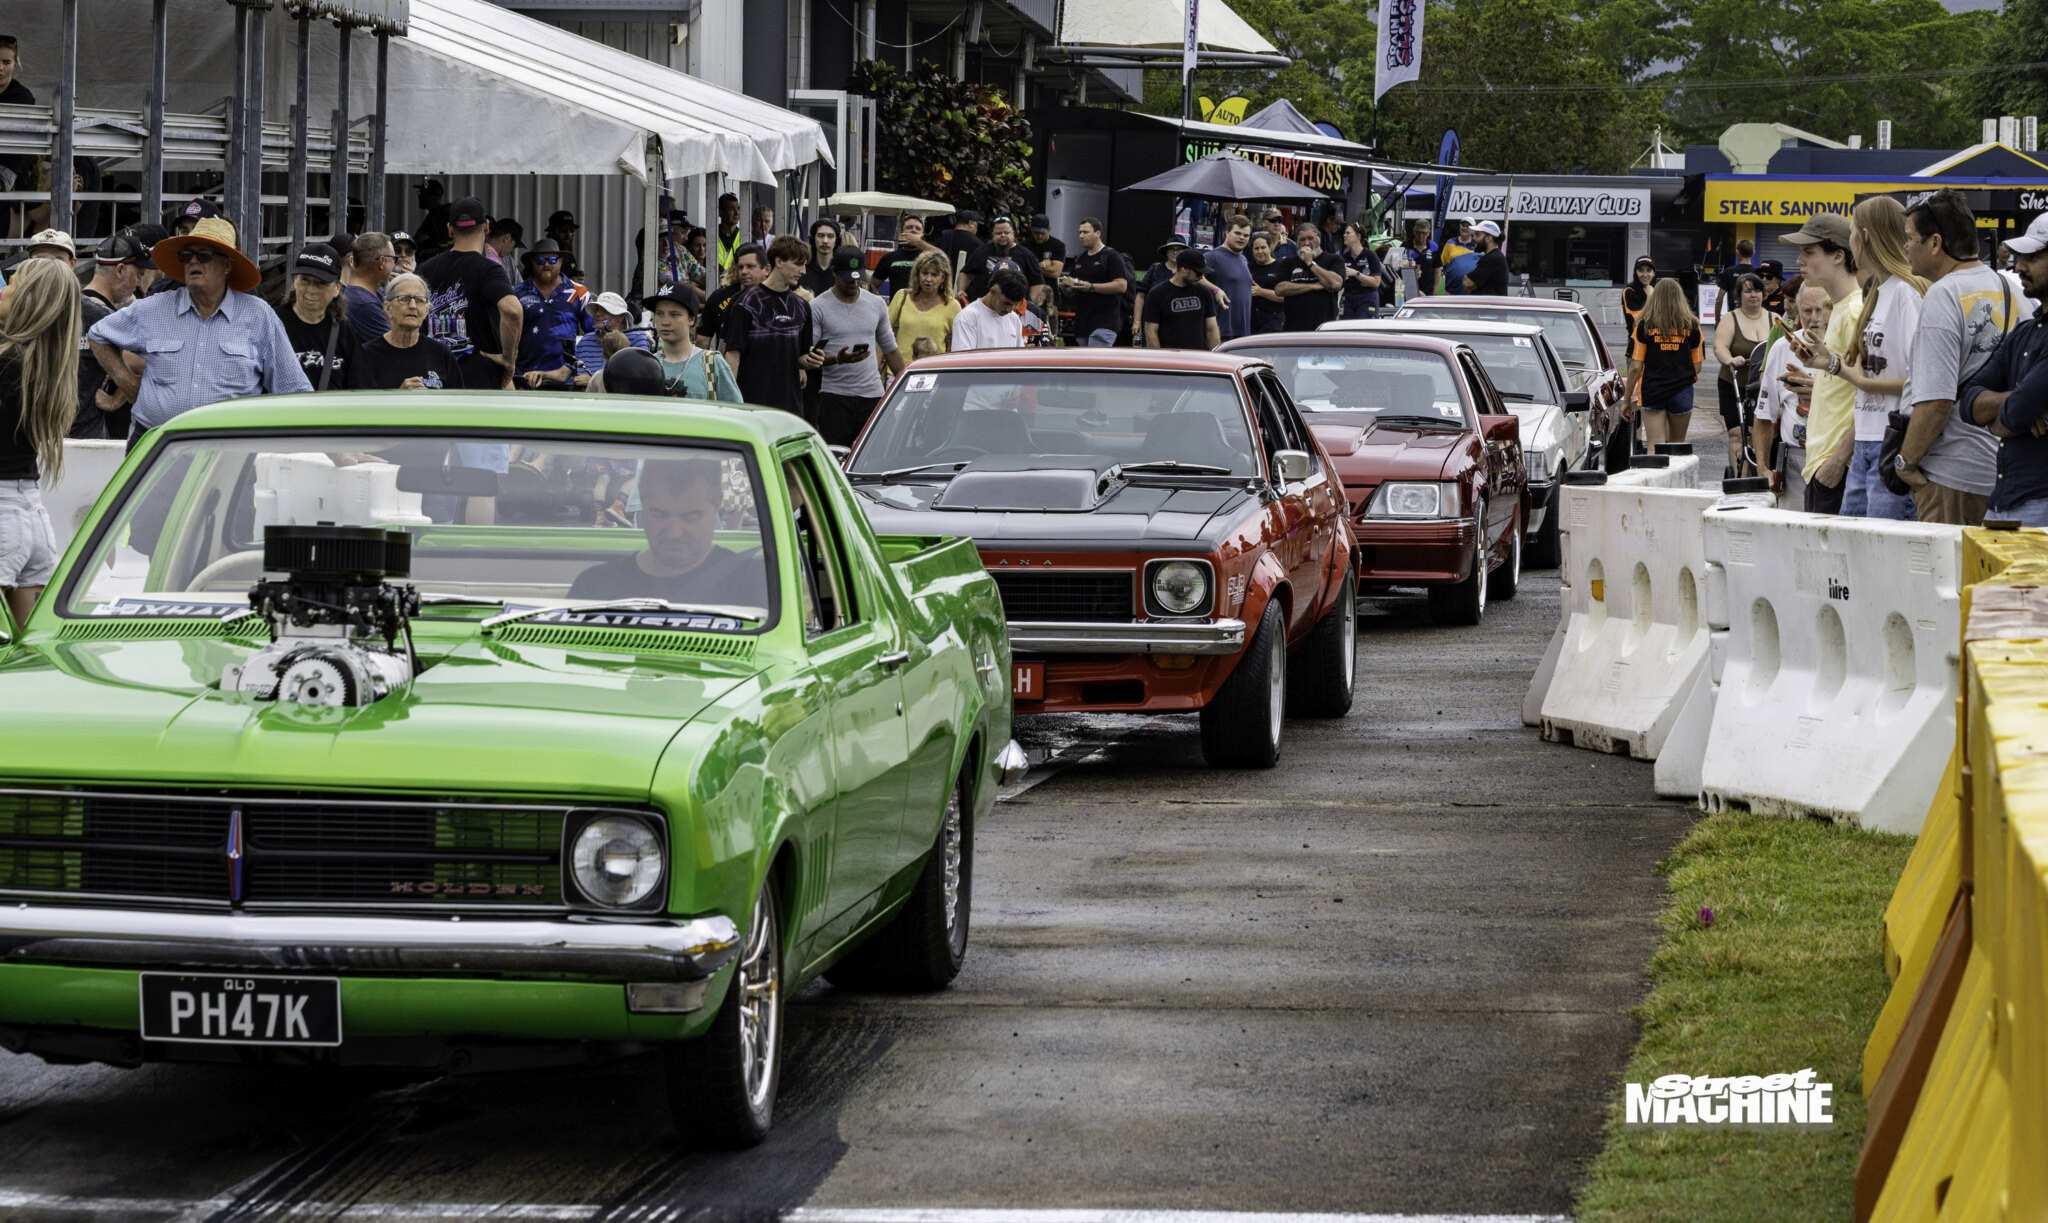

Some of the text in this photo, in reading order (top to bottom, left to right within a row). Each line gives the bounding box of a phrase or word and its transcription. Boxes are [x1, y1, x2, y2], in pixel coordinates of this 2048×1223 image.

[1216, 108, 1240, 126] AUTO
[1302, 159, 1342, 191] FLOSS
[1516, 191, 1593, 215] RAILWAY
[1595, 193, 1641, 216] CLUB
[1719, 200, 1773, 216] STEAK
[1175, 298, 1198, 310] ARB
[390, 881, 544, 895] HOLDEN
[224, 979, 255, 992] QLD
[169, 990, 310, 1039] PH47K
